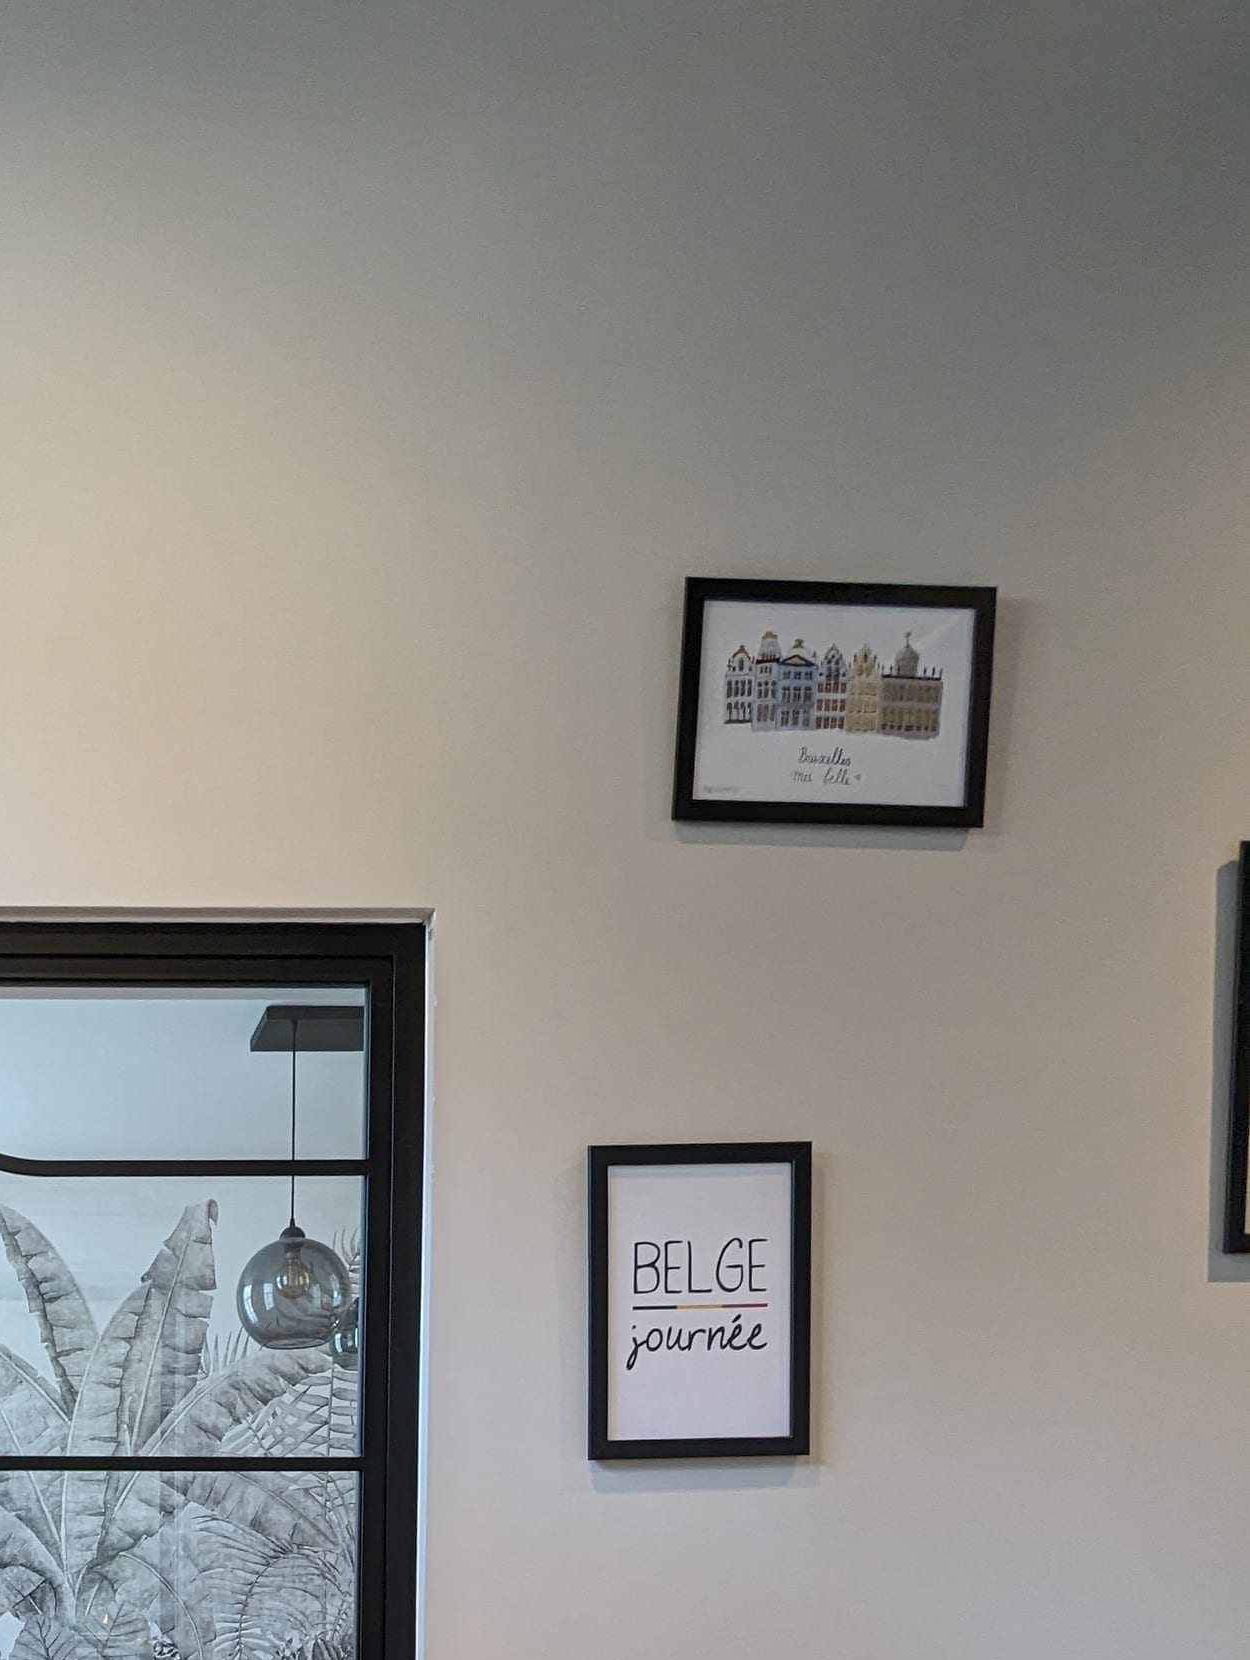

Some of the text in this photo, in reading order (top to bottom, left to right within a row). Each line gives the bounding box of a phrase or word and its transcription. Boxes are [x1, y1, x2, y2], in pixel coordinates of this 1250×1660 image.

[798, 746, 852, 766] Bruxelles
[632, 1237, 768, 1294] BELGE
[625, 1313, 769, 1371] journée
